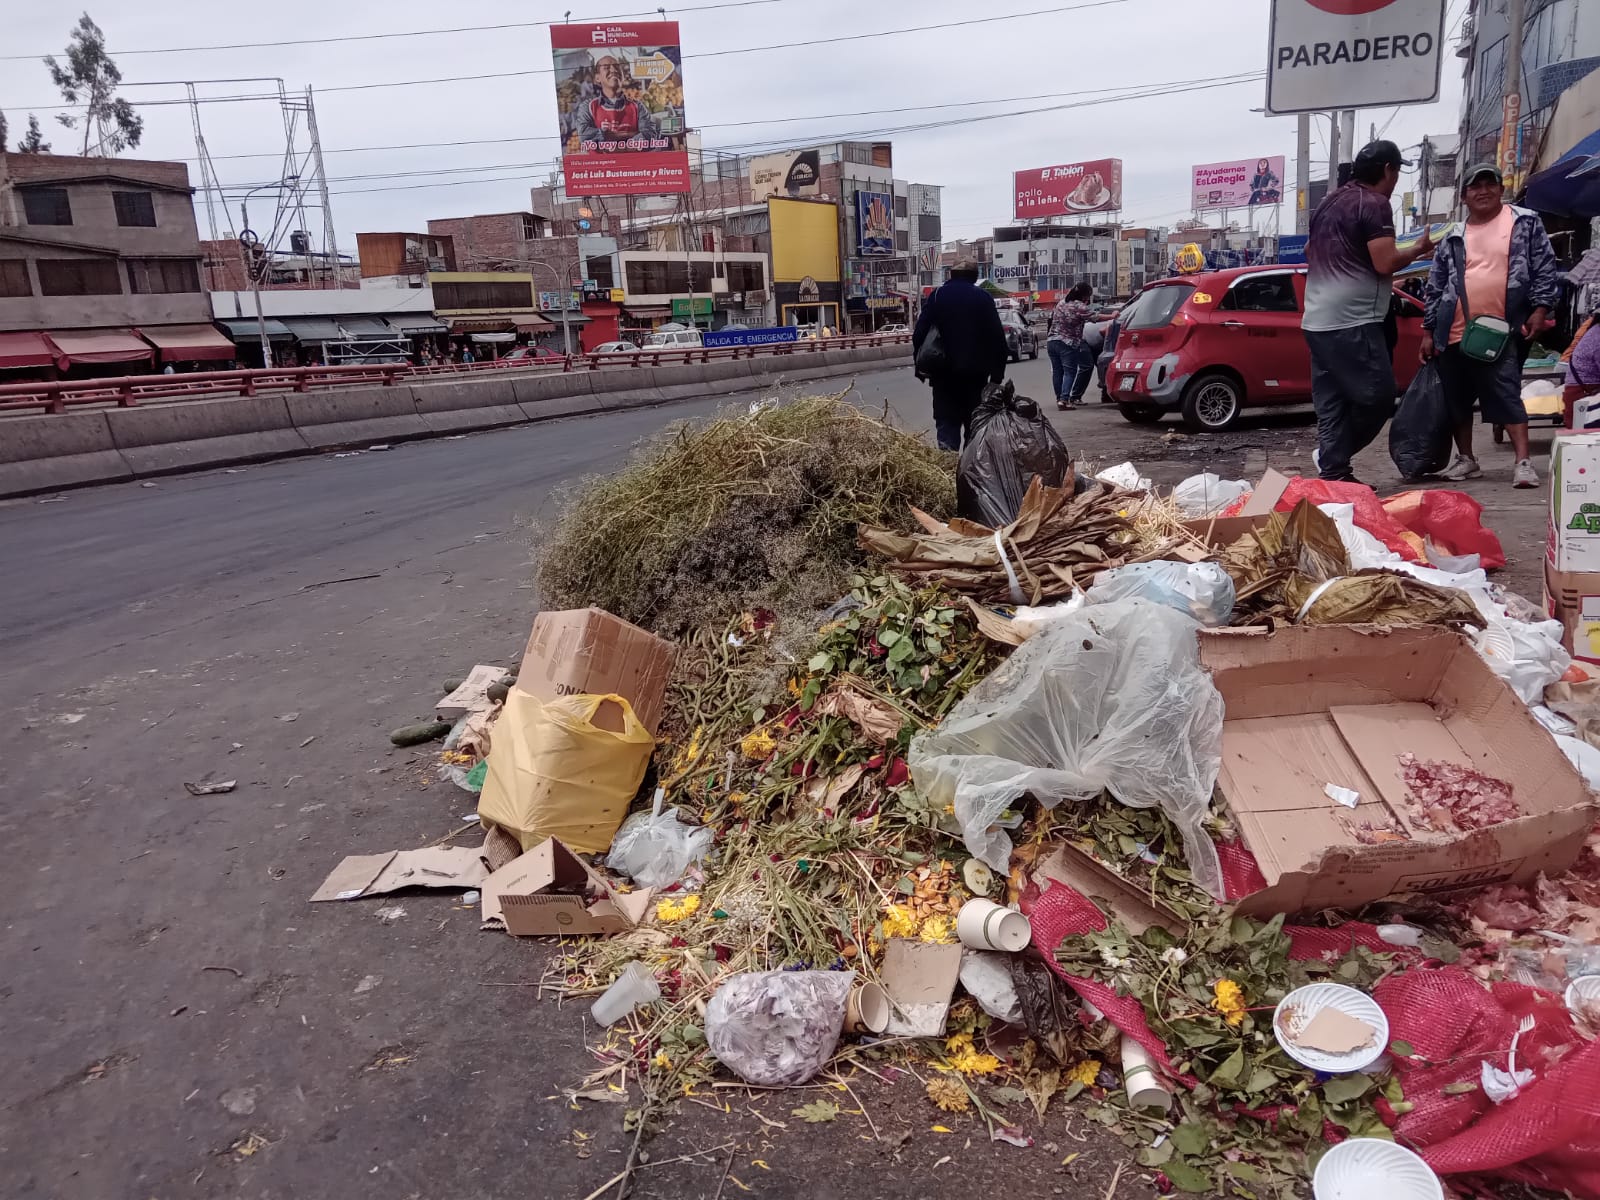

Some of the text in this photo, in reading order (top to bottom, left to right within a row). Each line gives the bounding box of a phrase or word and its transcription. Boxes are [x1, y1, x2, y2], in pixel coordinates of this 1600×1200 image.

[1278, 32, 1433, 69] PARADERO
[598, 141, 617, 151] voy
[618, 140, 625, 149] a
[627, 138, 649, 151] Caja
[650, 136, 669, 148] Ica!
[571, 169, 589, 179] José
[589, 169, 604, 179] Luis
[651, 169, 658, 178] y
[1041, 168, 1050, 178] El
[1053, 165, 1085, 177] Tablón
[1196, 173, 1246, 186] EsLaRegla
[1018, 188, 1042, 200] pollo
[1026, 198, 1035, 206] la
[1037, 195, 1061, 205] leña.
[706, 332, 795, 346] SALIDA DE EMERGENCIA
